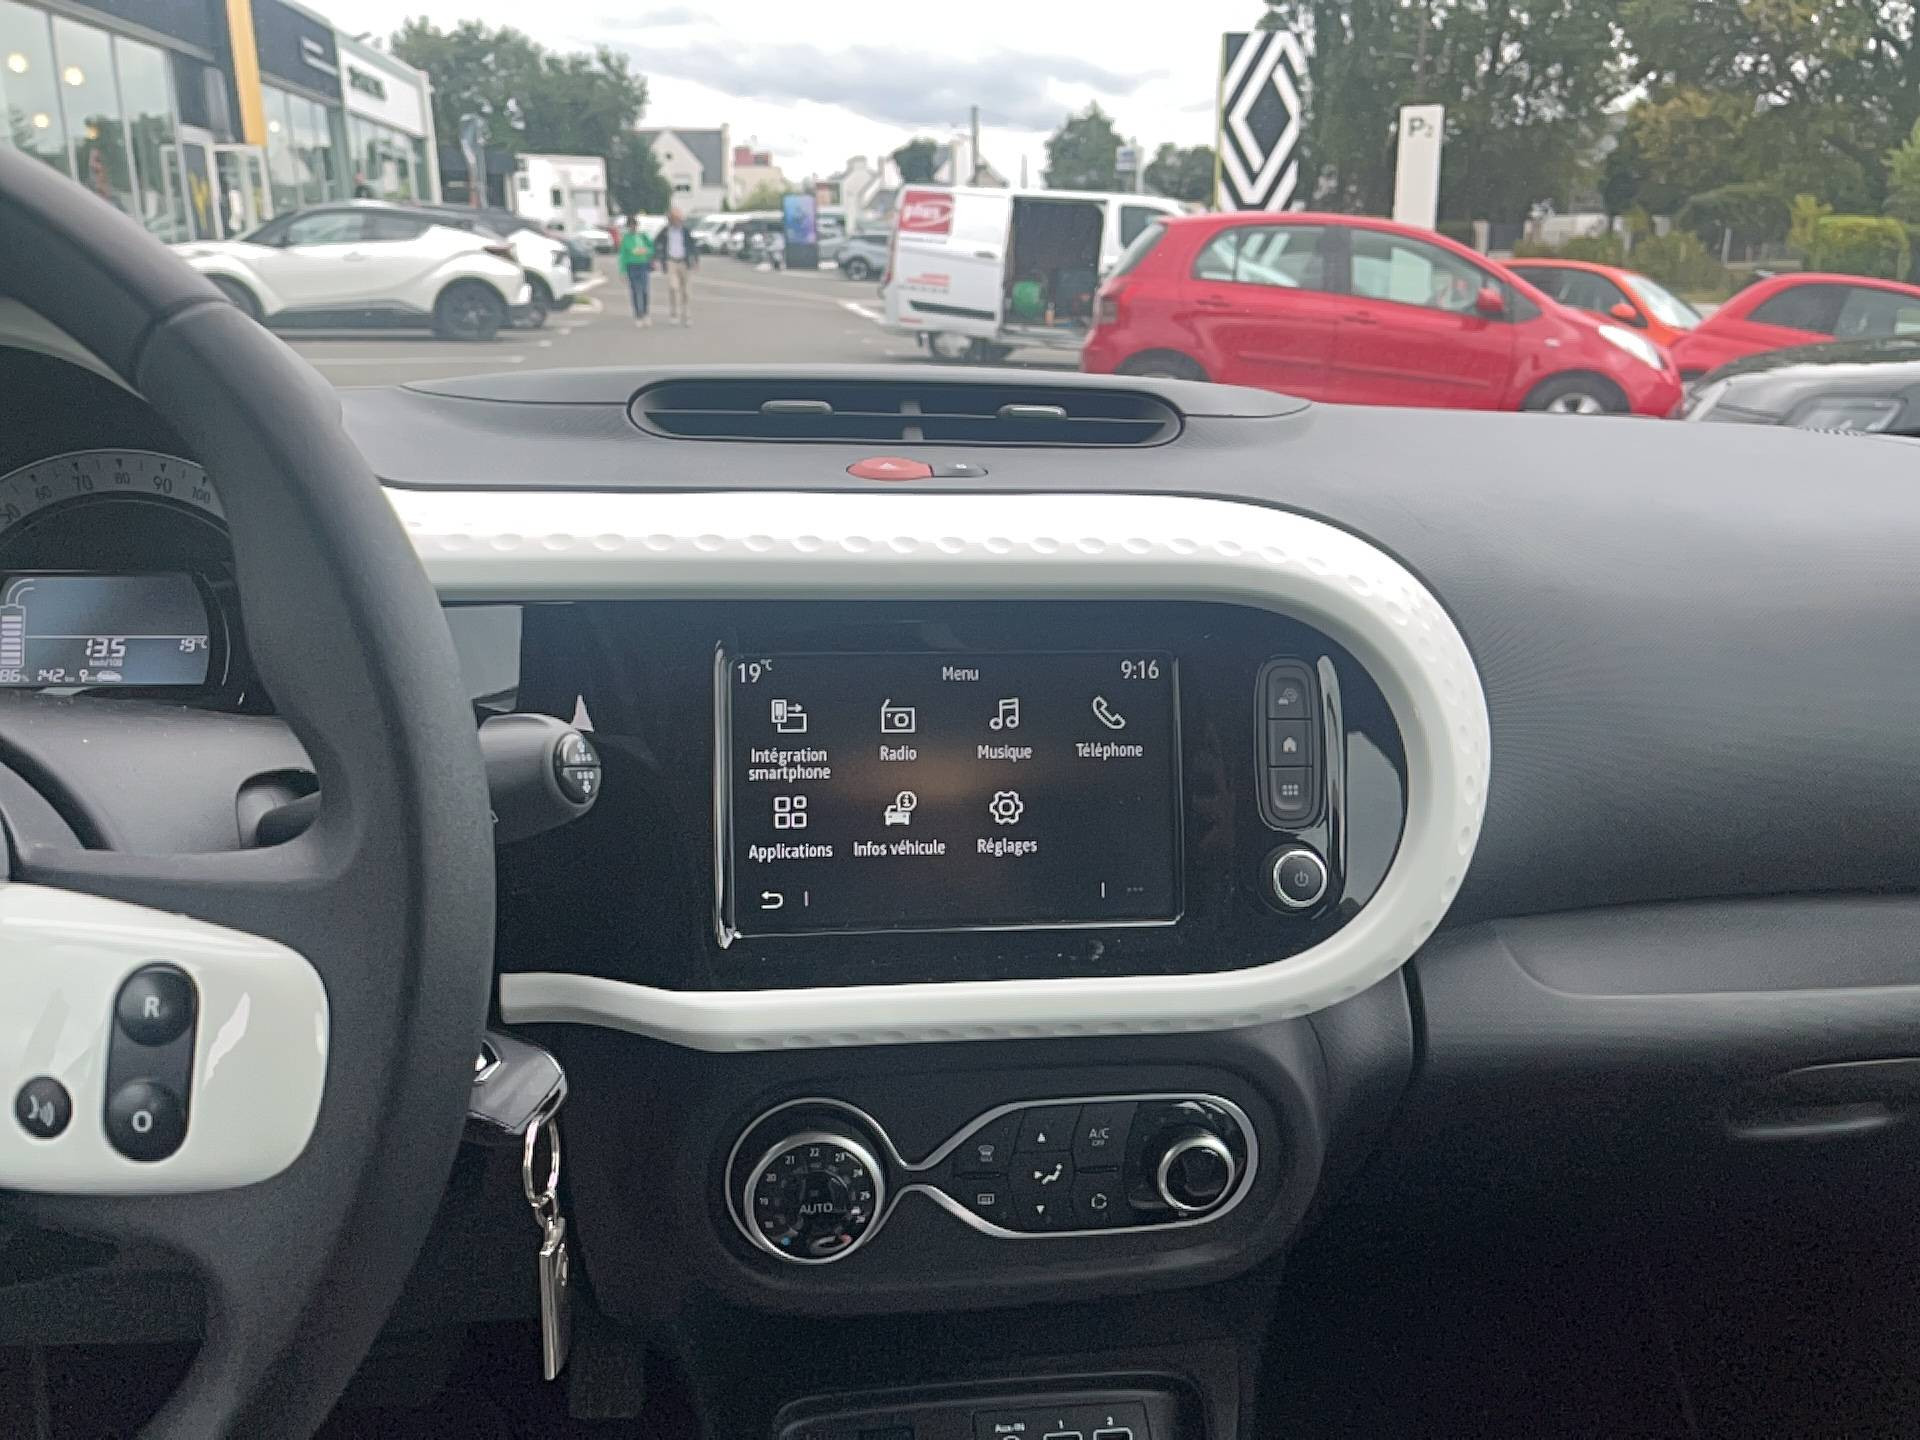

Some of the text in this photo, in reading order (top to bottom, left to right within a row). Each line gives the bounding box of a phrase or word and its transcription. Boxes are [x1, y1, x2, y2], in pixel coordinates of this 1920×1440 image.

[72, 474, 94, 491] 70
[152, 475, 173, 494] 90
[942, 666, 980, 681] Menu
[1121, 660, 1160, 679] 9:16
[751, 747, 828, 766] Intégration
[880, 745, 917, 761] Radio
[977, 744, 1033, 762] Musique
[1076, 741, 1144, 760] Téléphone
[748, 764, 832, 783] smartphone
[749, 843, 833, 863] Applications
[853, 839, 946, 857] Infos véhicule
[977, 837, 1038, 856] Réglages
[144, 997, 160, 1018] R
[1089, 1127, 1110, 1139] A/C
[799, 1202, 834, 1215] AUTO
